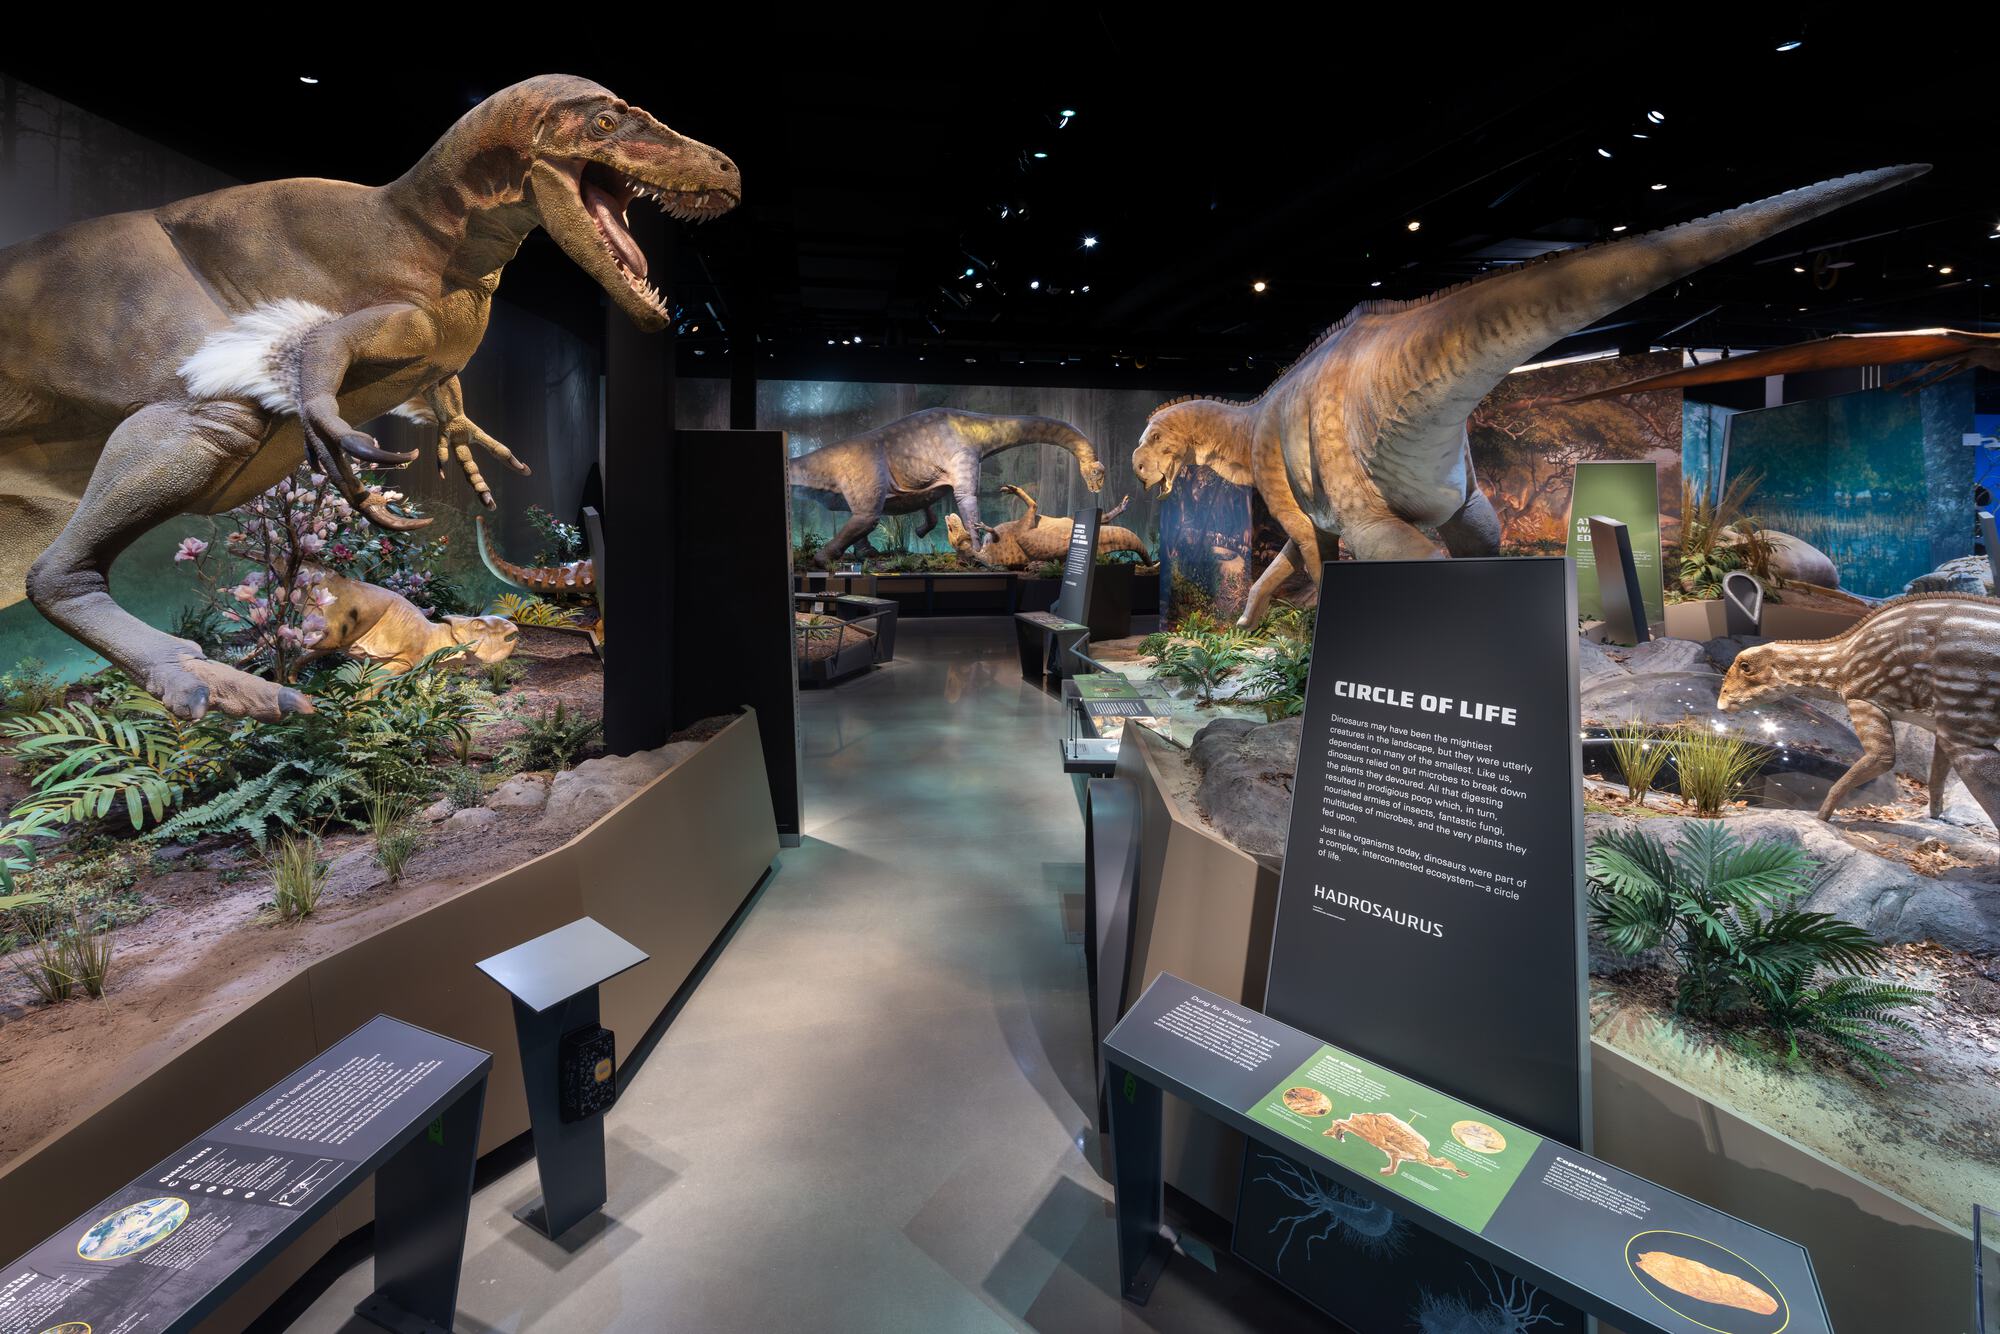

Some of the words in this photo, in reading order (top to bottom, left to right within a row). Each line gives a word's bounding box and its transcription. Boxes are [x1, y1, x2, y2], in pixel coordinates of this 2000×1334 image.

[1334, 680, 1414, 708] CIRCLE
[1420, 694, 1453, 714] OF
[1459, 700, 1517, 726] LIFE
[1329, 727, 1365, 739] creatures
[1366, 732, 1374, 741] in
[1376, 734, 1390, 745] the
[1391, 737, 1435, 754] landscape,
[1437, 746, 1452, 757] but
[1454, 750, 1474, 763] they
[1476, 756, 1500, 767] were
[1502, 761, 1533, 774] utterly
[1331, 713, 1369, 728] Dinosaurs
[1370, 722, 1388, 733] may
[1389, 724, 1409, 736] have
[1410, 728, 1432, 740] been
[1433, 733, 1448, 743] the
[1450, 737, 1492, 752] mightiest
[1327, 749, 1364, 764] dinosaurs
[1365, 758, 1389, 769] relied
[1389, 763, 1401, 771] on
[1402, 766, 1416, 775] gut
[1418, 769, 1458, 784] microbes
[1460, 778, 1470, 787] to
[1472, 779, 1498, 793] break
[1500, 786, 1527, 799] down
[1328, 737, 1369, 753] dependent
[1370, 747, 1382, 755] on
[1383, 749, 1406, 761] many
[1407, 753, 1417, 762] of
[1418, 755, 1433, 766] the
[1434, 760, 1474, 774] smallest.
[1476, 767, 1496, 779] Like
[1498, 773, 1512, 783] us,
[1325, 773, 1357, 786] resulted
[1357, 779, 1366, 788] in
[1366, 783, 1409, 799] prodigious
[1410, 793, 1433, 805] poop
[1434, 799, 1463, 813] which,
[1465, 804, 1474, 814] in
[1476, 808, 1498, 821] turn,
[1326, 760, 1339, 770] the
[1340, 764, 1364, 776] plants
[1365, 769, 1384, 781] they
[1384, 774, 1429, 790] devoured.
[1427, 783, 1440, 793] All
[1441, 786, 1459, 798] that
[1461, 791, 1503, 809] digesting
[1322, 807, 1335, 817] fed
[1335, 812, 1357, 824] upon.
[1322, 797, 1363, 813] multitudes
[1364, 806, 1374, 815] of
[1375, 810, 1419, 827] microbes,
[1417, 821, 1434, 831] and
[1436, 824, 1451, 835] the
[1452, 830, 1473, 842] very
[1474, 835, 1503, 849] plants
[1505, 842, 1527, 856] they
[1324, 785, 1362, 800] nourished
[1363, 794, 1391, 807] armies
[1392, 801, 1402, 809] of
[1403, 802, 1436, 819] insects,
[1438, 811, 1477, 828] fantastic
[1479, 821, 1505, 836] fungi,
[1317, 848, 1326, 857] of
[1327, 850, 1341, 862] life.
[1319, 824, 1337, 836] Just
[1338, 828, 1352, 840] like
[1353, 834, 1395, 852] organisms
[1396, 846, 1421, 860] today,
[1423, 853, 1466, 872] dinosaurs
[1468, 866, 1493, 879] were
[1494, 873, 1514, 885] part
[1516, 879, 1527, 888] of
[1325, 839, 1360, 855] complex,
[1362, 848, 1424, 873] interconnected
[1493, 886, 1520, 901] circle
[1314, 884, 1443, 937] HADROSAURUS
[1190, 995, 1211, 1007] Dung
[1210, 1004, 1222, 1012] for
[1221, 1009, 1252, 1024] Dinner?
[233, 1111, 266, 1131] Fierce
[265, 1098, 284, 1111] and
[281, 1069, 326, 1098] Feathered
[1556, 1156, 1607, 1182] Coprolites
